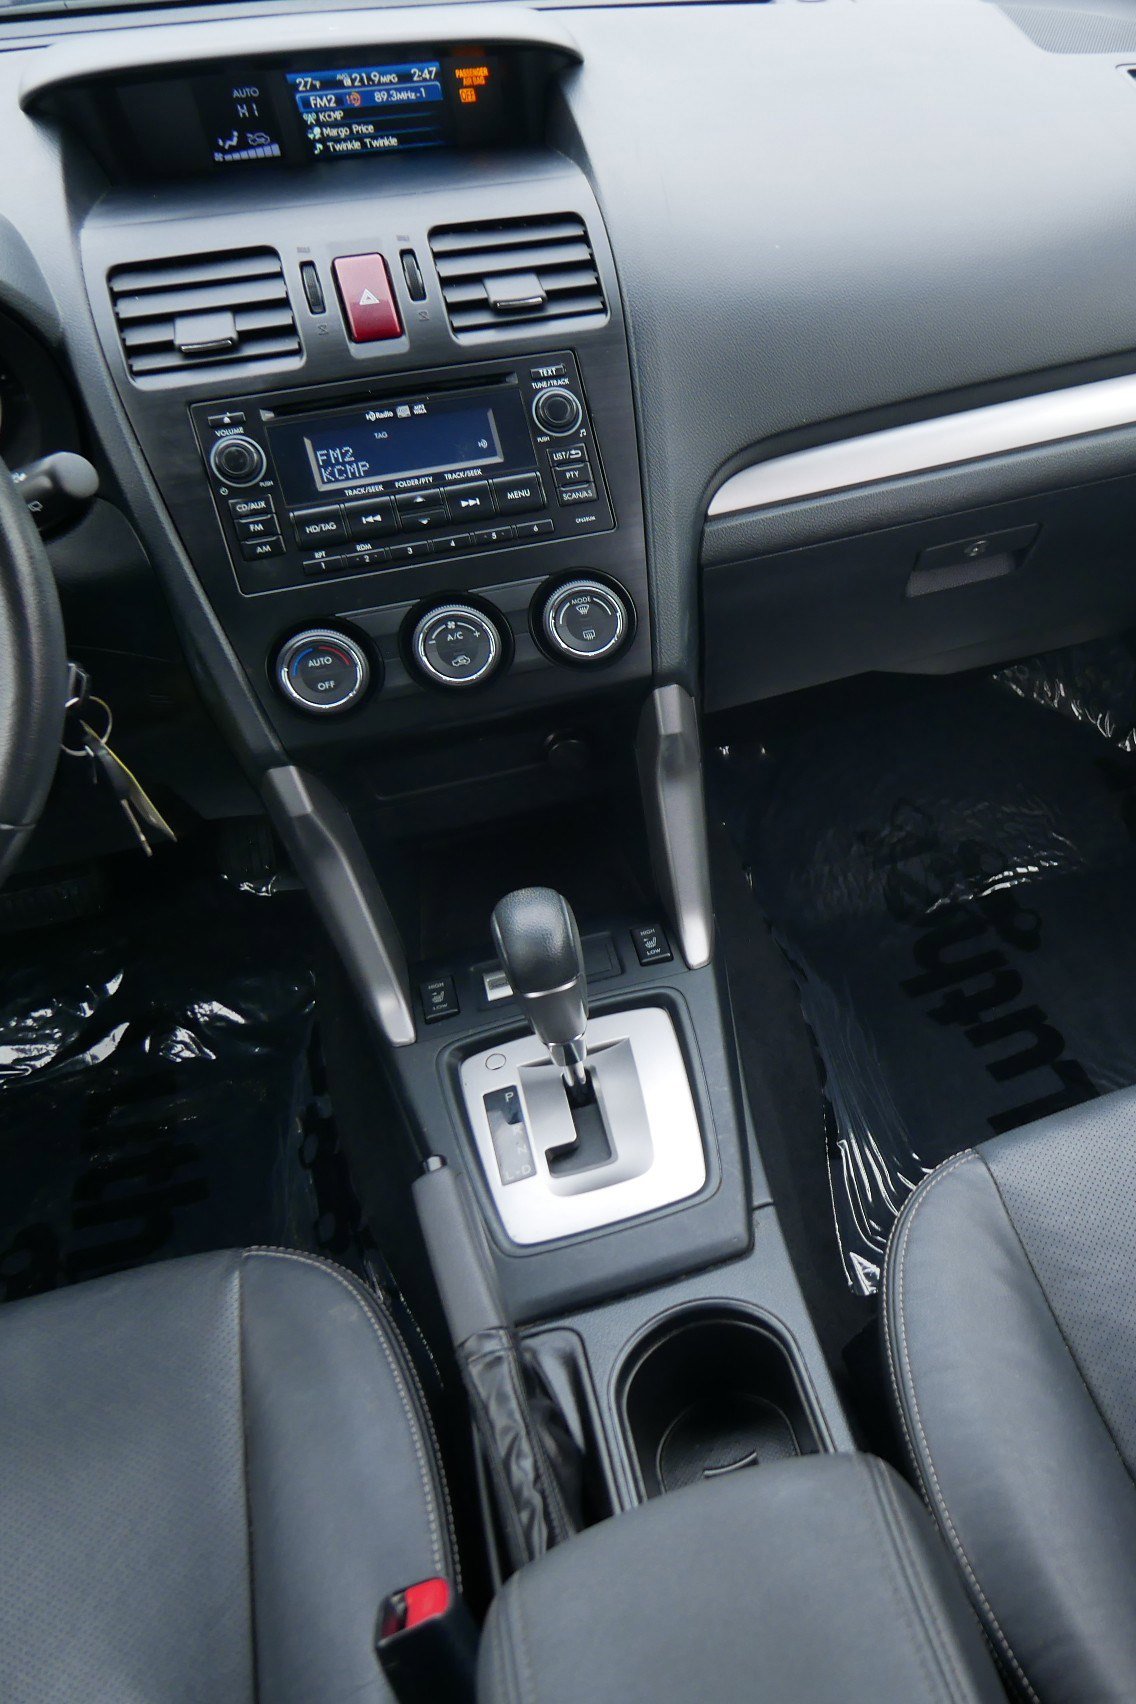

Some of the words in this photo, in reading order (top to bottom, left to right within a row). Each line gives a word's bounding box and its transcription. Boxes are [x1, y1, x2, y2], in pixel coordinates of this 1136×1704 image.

[410, 67, 437, 82] 2:47
[232, 86, 259, 99] AUTO
[460, 89, 475, 102] OFF
[309, 94, 337, 109] FM2
[319, 110, 344, 122] KCMP
[322, 127, 350, 139] Margo
[352, 124, 374, 134] Price
[326, 140, 361, 153] Twinkle
[364, 136, 398, 148] Twinkle
[538, 368, 557, 378] TEXT
[531, 378, 570, 390] TUNE/TRACK
[214, 426, 245, 438] VOLUME
[374, 431, 388, 440] TAG
[316, 446, 355, 466] FM2
[321, 460, 370, 482] KCMP
[443, 468, 483, 481] TRACK/SEEK
[565, 470, 580, 480] PTY
[395, 475, 434, 489] FOLDER/PTY
[344, 483, 384, 496] TRACK/SEEK
[507, 488, 531, 500] MENU
[236, 500, 267, 513] CD/AUX
[249, 523, 264, 533] FM
[304, 521, 337, 534] HD/TAG
[255, 544, 272, 554] AM
[355, 543, 372, 552] RDM
[314, 550, 326, 559] RPT
[570, 595, 592, 606] MODE
[446, 630, 464, 642] A/C
[308, 656, 333, 669] AUTO
[317, 679, 336, 692] OFF
[646, 948, 661, 956] LOW
[505, 1091, 515, 1104] P
